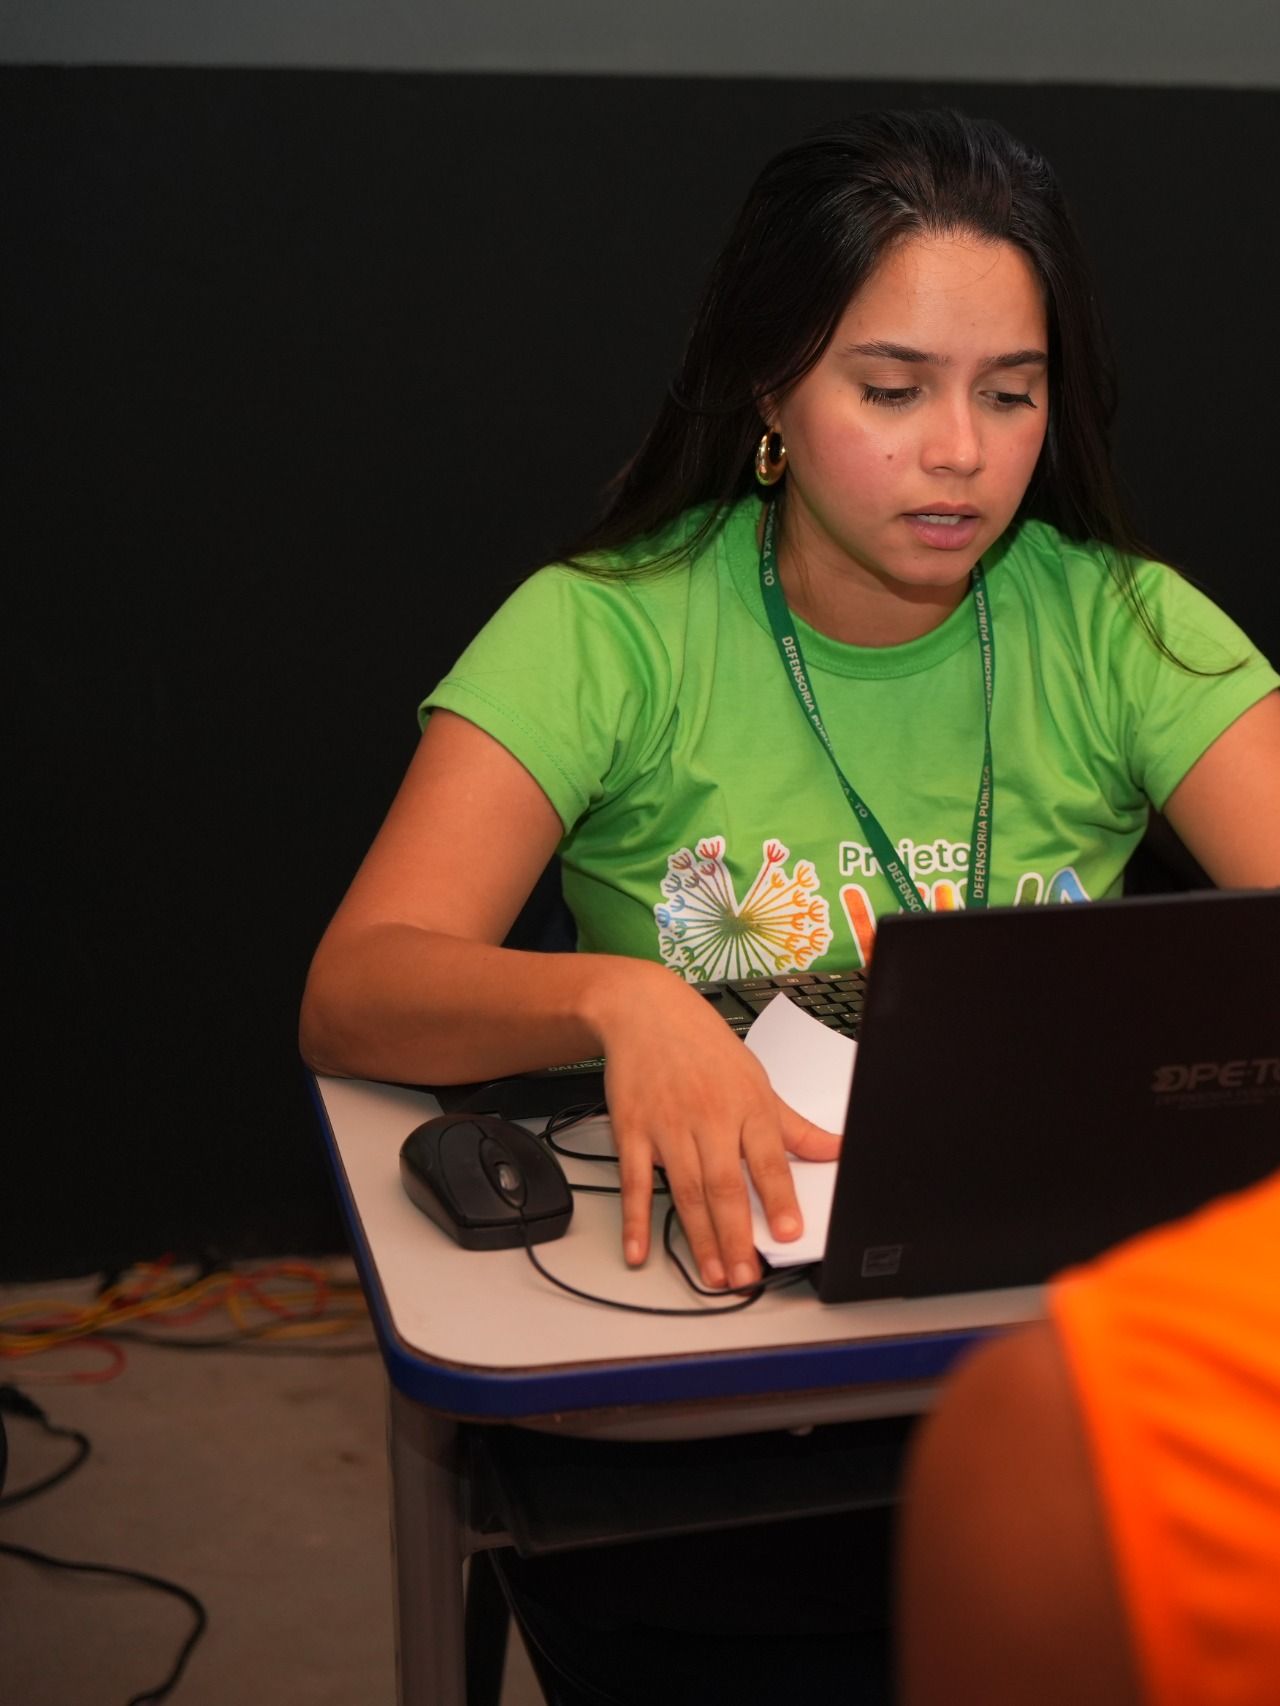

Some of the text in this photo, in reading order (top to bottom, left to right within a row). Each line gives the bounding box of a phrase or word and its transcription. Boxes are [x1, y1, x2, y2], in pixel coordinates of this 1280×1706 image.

[763, 567, 775, 586] TO
[975, 590, 990, 642] PÚBLICA
[782, 635, 816, 713] DEFENSORIA
[855, 802, 869, 818] TO
[841, 841, 970, 878] Prjeto
[973, 820, 988, 899] DEFENSORIA
[548, 1061, 606, 1072] OSITIVO
